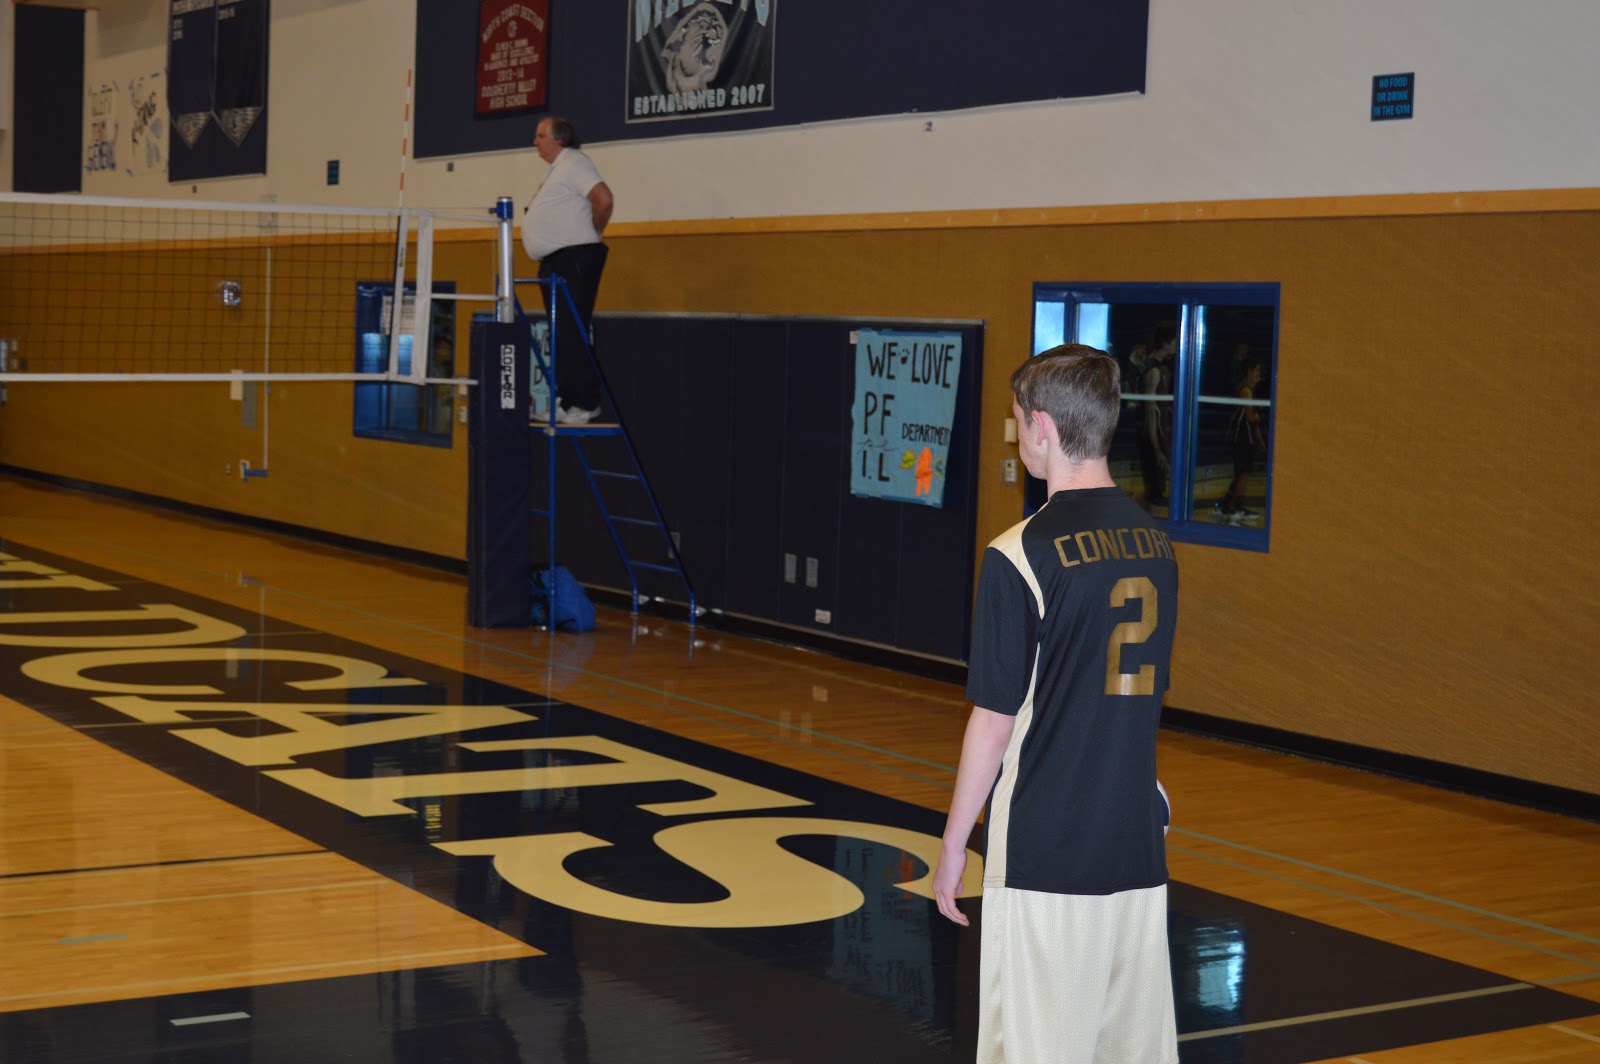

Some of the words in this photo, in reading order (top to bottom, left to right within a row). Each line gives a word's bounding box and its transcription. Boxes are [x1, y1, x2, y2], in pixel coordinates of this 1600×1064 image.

[501, 4, 520, 22] COAST
[520, 6, 544, 32] SECTION
[1378, 79, 1389, 88] NO
[1390, 77, 1408, 88] FOOD
[505, 94, 528, 108] SCHOOL
[634, 88, 726, 116] ESTABLISHED
[731, 84, 766, 106] 2007
[1376, 92, 1386, 102] OR
[1387, 90, 1408, 102] DRINK
[1374, 106, 1381, 116] IN
[1382, 105, 1394, 116] THE
[1396, 104, 1410, 114] GYM
[866, 342, 898, 380] WE
[911, 342, 955, 388] LOVE
[1104, 576, 1158, 696] 2
